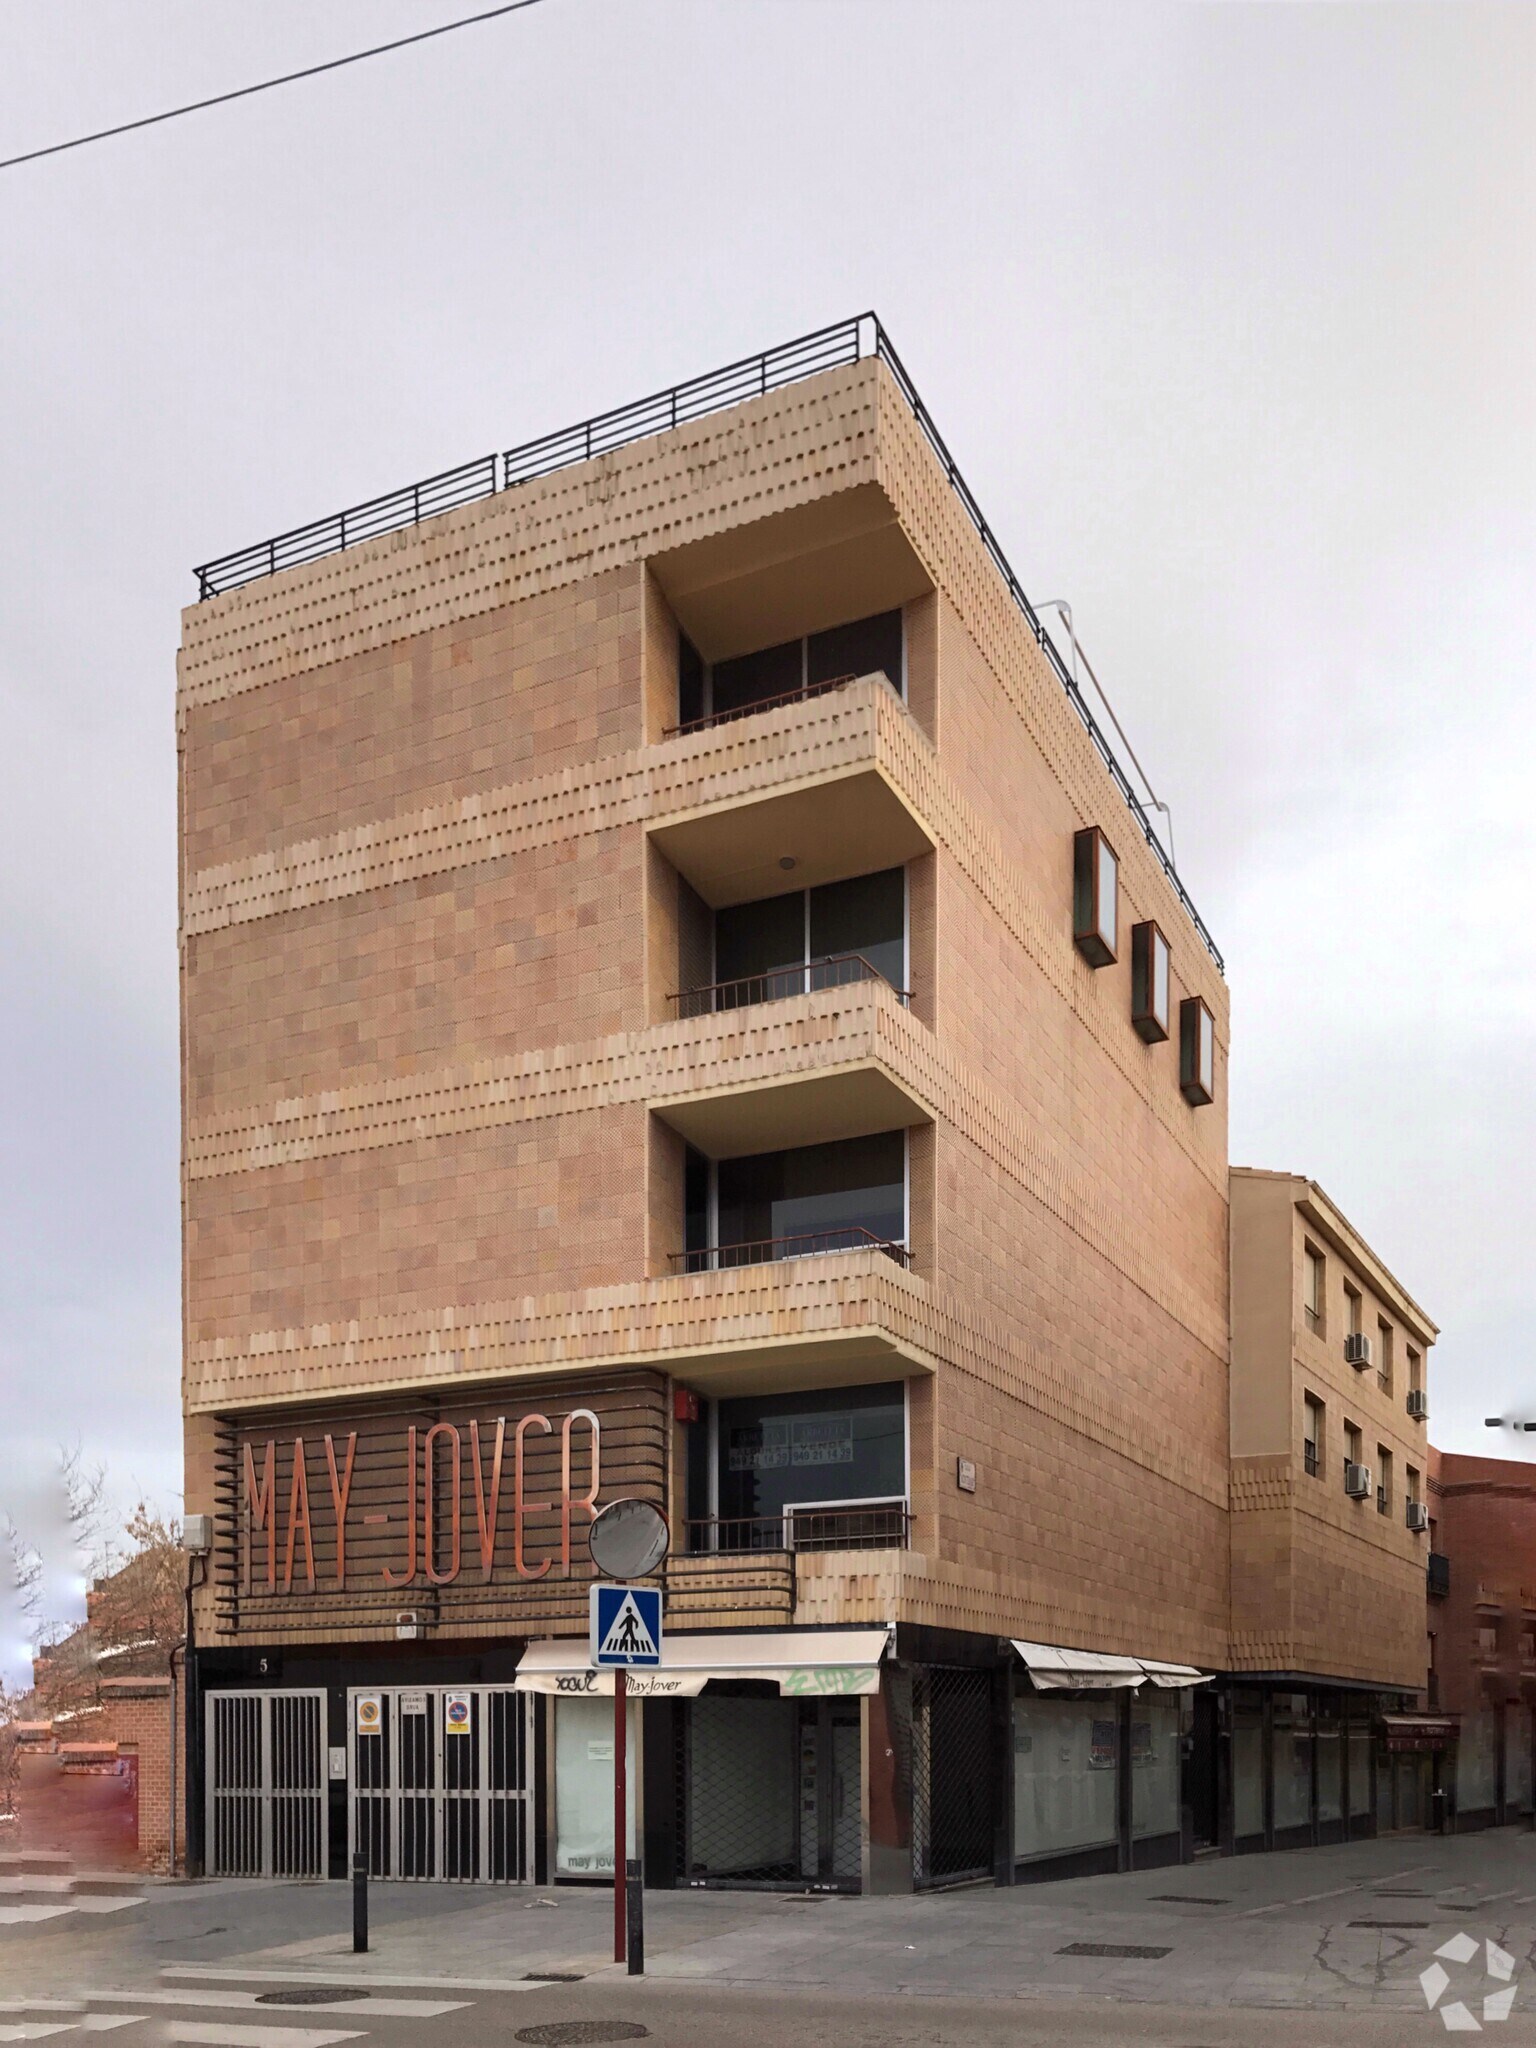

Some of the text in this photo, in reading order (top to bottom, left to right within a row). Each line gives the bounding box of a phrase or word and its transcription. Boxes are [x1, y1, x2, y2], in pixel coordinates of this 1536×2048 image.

[260, 1658, 268, 1672] 5
[568, 1857, 615, 1870] may jov
